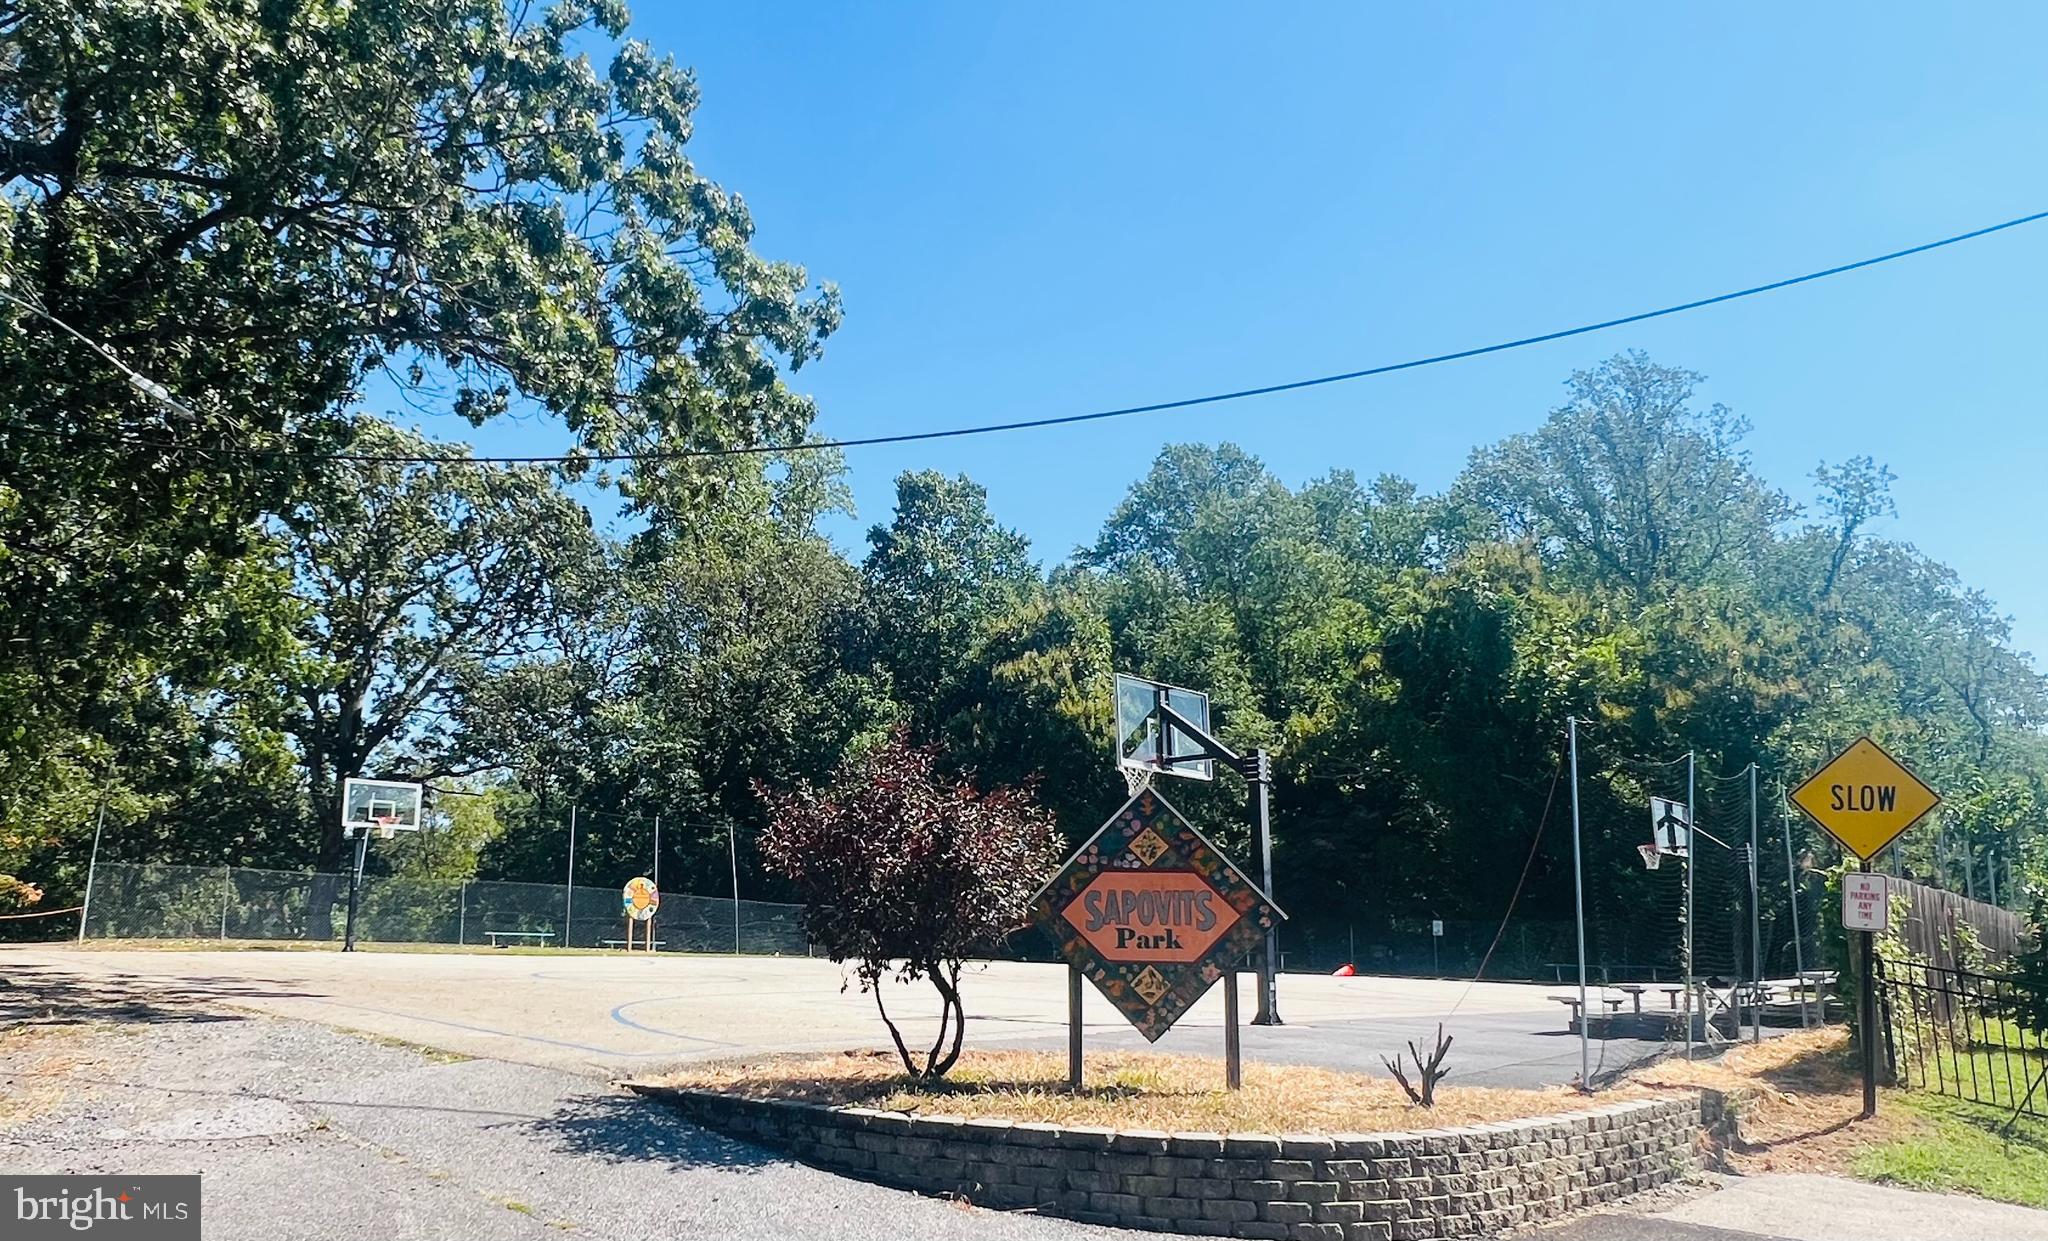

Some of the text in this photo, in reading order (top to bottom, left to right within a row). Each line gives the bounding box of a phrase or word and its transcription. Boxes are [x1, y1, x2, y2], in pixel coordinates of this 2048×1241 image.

[1831, 784, 1896, 812] SLOW
[1860, 882, 1871, 891] NO
[1850, 892, 1880, 901] PARKING
[1083, 889, 1217, 932] SAPOVITS
[1858, 902, 1873, 910] ANY
[1858, 911, 1873, 920] TIME
[1115, 928, 1183, 950] Park
